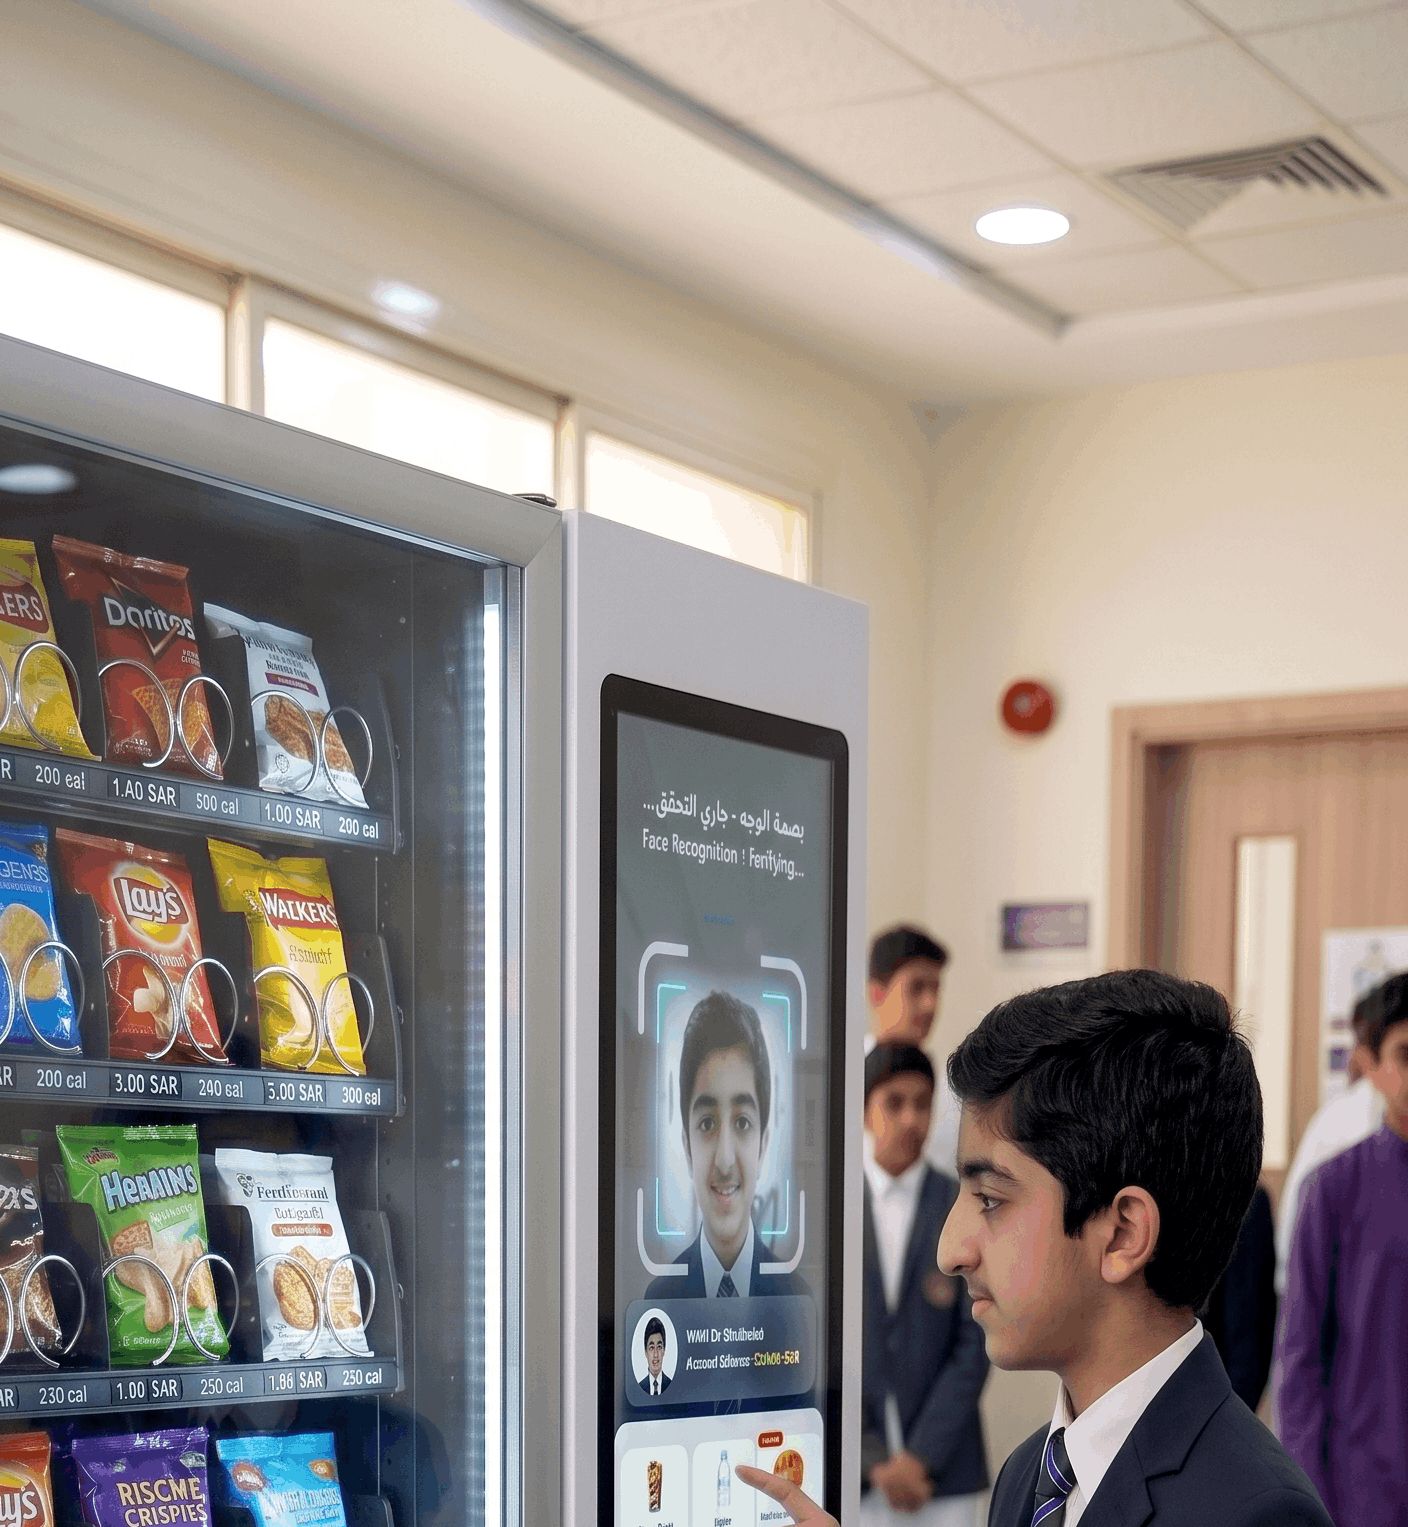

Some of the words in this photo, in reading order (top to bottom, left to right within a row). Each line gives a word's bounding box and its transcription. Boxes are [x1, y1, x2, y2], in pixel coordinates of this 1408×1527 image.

[0, 593, 43, 621] ERS
[103, 597, 196, 640] Doritos
[36, 765, 60, 785] 200
[148, 784, 177, 806] SAR
[196, 793, 218, 811] 500
[265, 803, 292, 824] 1.00
[296, 808, 321, 829] SAR
[338, 817, 359, 835] 200
[700, 800, 728, 831] جاري
[740, 809, 770, 836] الوجه
[773, 812, 804, 844] بصمة
[643, 828, 669, 851] Face
[672, 833, 738, 864] Recognition
[120, 879, 181, 923] Lay's
[259, 890, 338, 928] WALKERS
[0, 1066, 13, 1087] R
[36, 1069, 62, 1088] 200
[115, 1073, 144, 1093] 3.00
[150, 1075, 178, 1095] SAR
[299, 1084, 324, 1102] SAR
[342, 1087, 362, 1104] 300
[200, 1378, 223, 1395] 250
[226, 1377, 243, 1393] cal
[300, 1371, 323, 1388] SAR
[365, 1368, 382, 1384] cal
[39, 1387, 65, 1405] 230
[67, 1385, 87, 1403] cal
[116, 1381, 145, 1400] 1.00
[152, 1379, 178, 1398] SAR
[124, 1503, 208, 1527] CRISPIES
